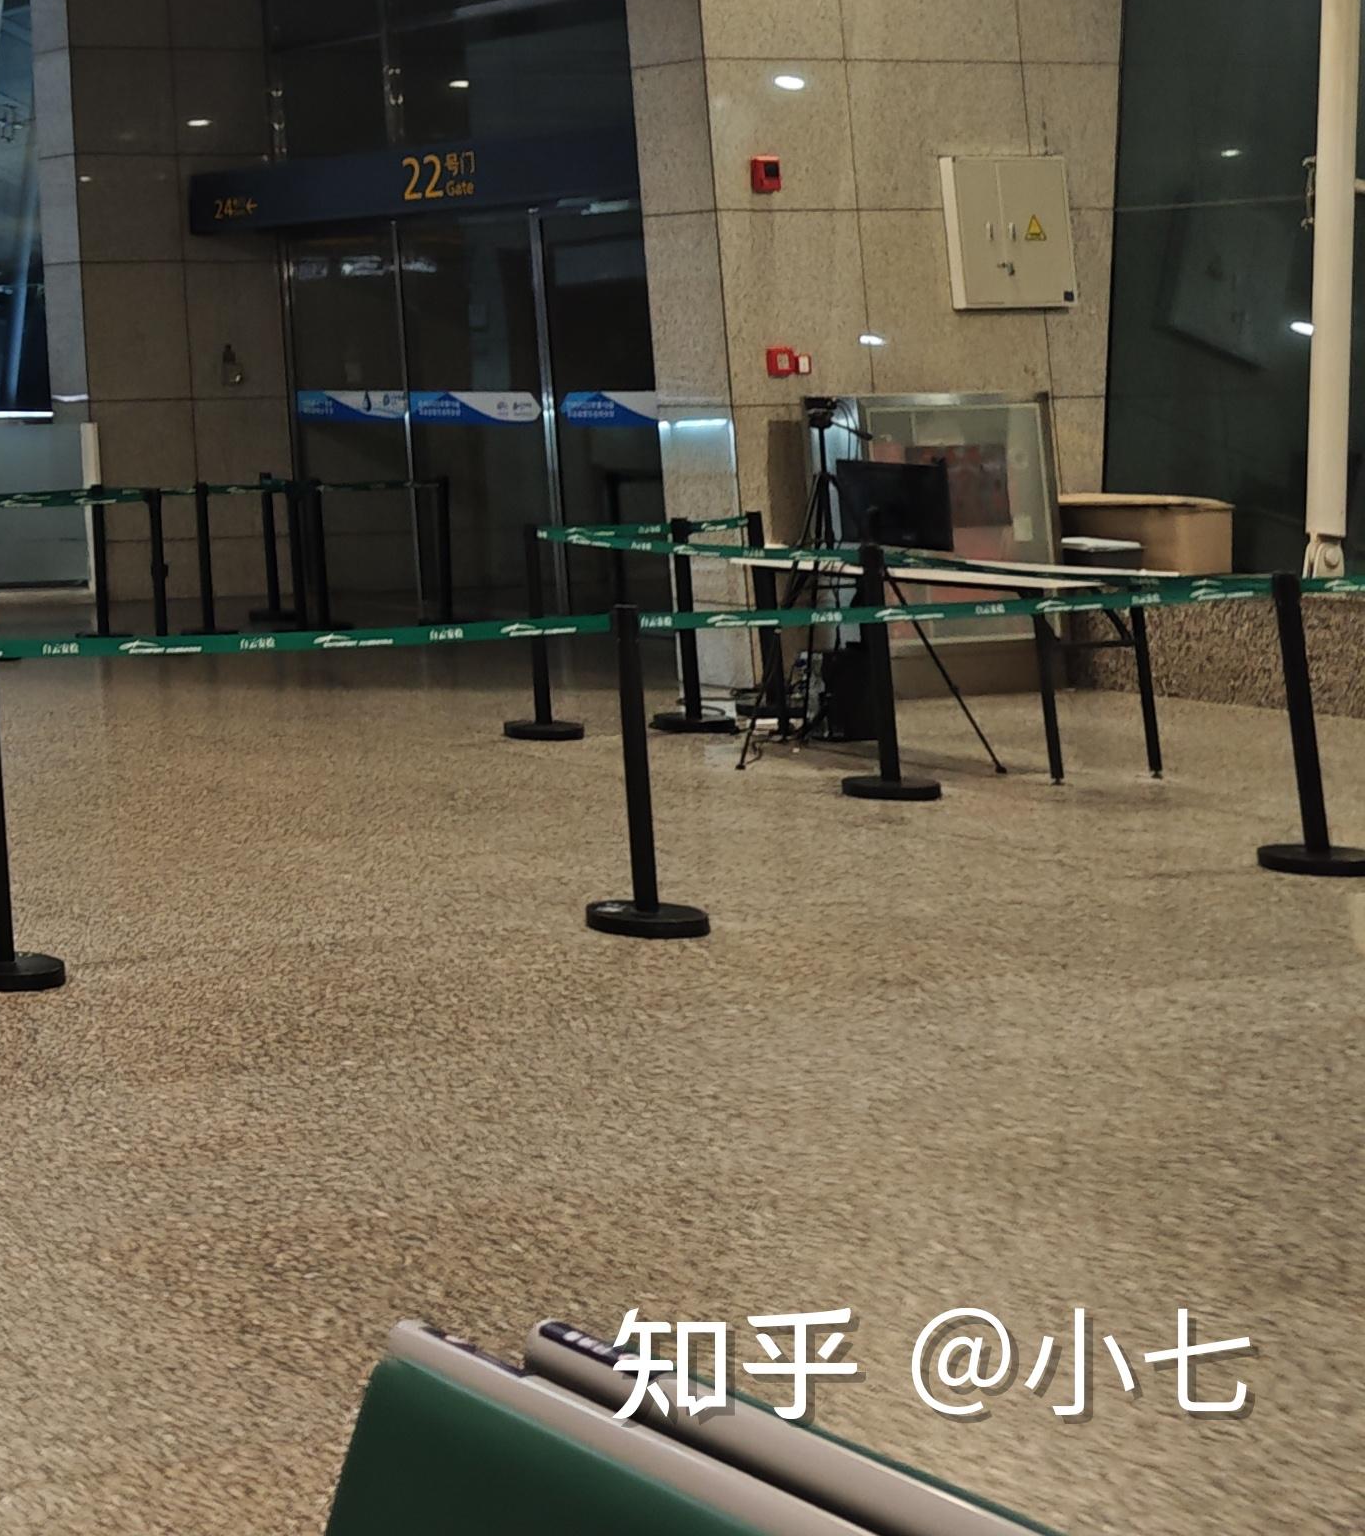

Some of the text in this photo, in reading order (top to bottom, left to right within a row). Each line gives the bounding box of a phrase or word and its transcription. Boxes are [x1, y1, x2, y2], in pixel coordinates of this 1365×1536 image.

[445, 151, 475, 176] 号门
[402, 154, 444, 201] 22
[445, 180, 475, 197] Gate
